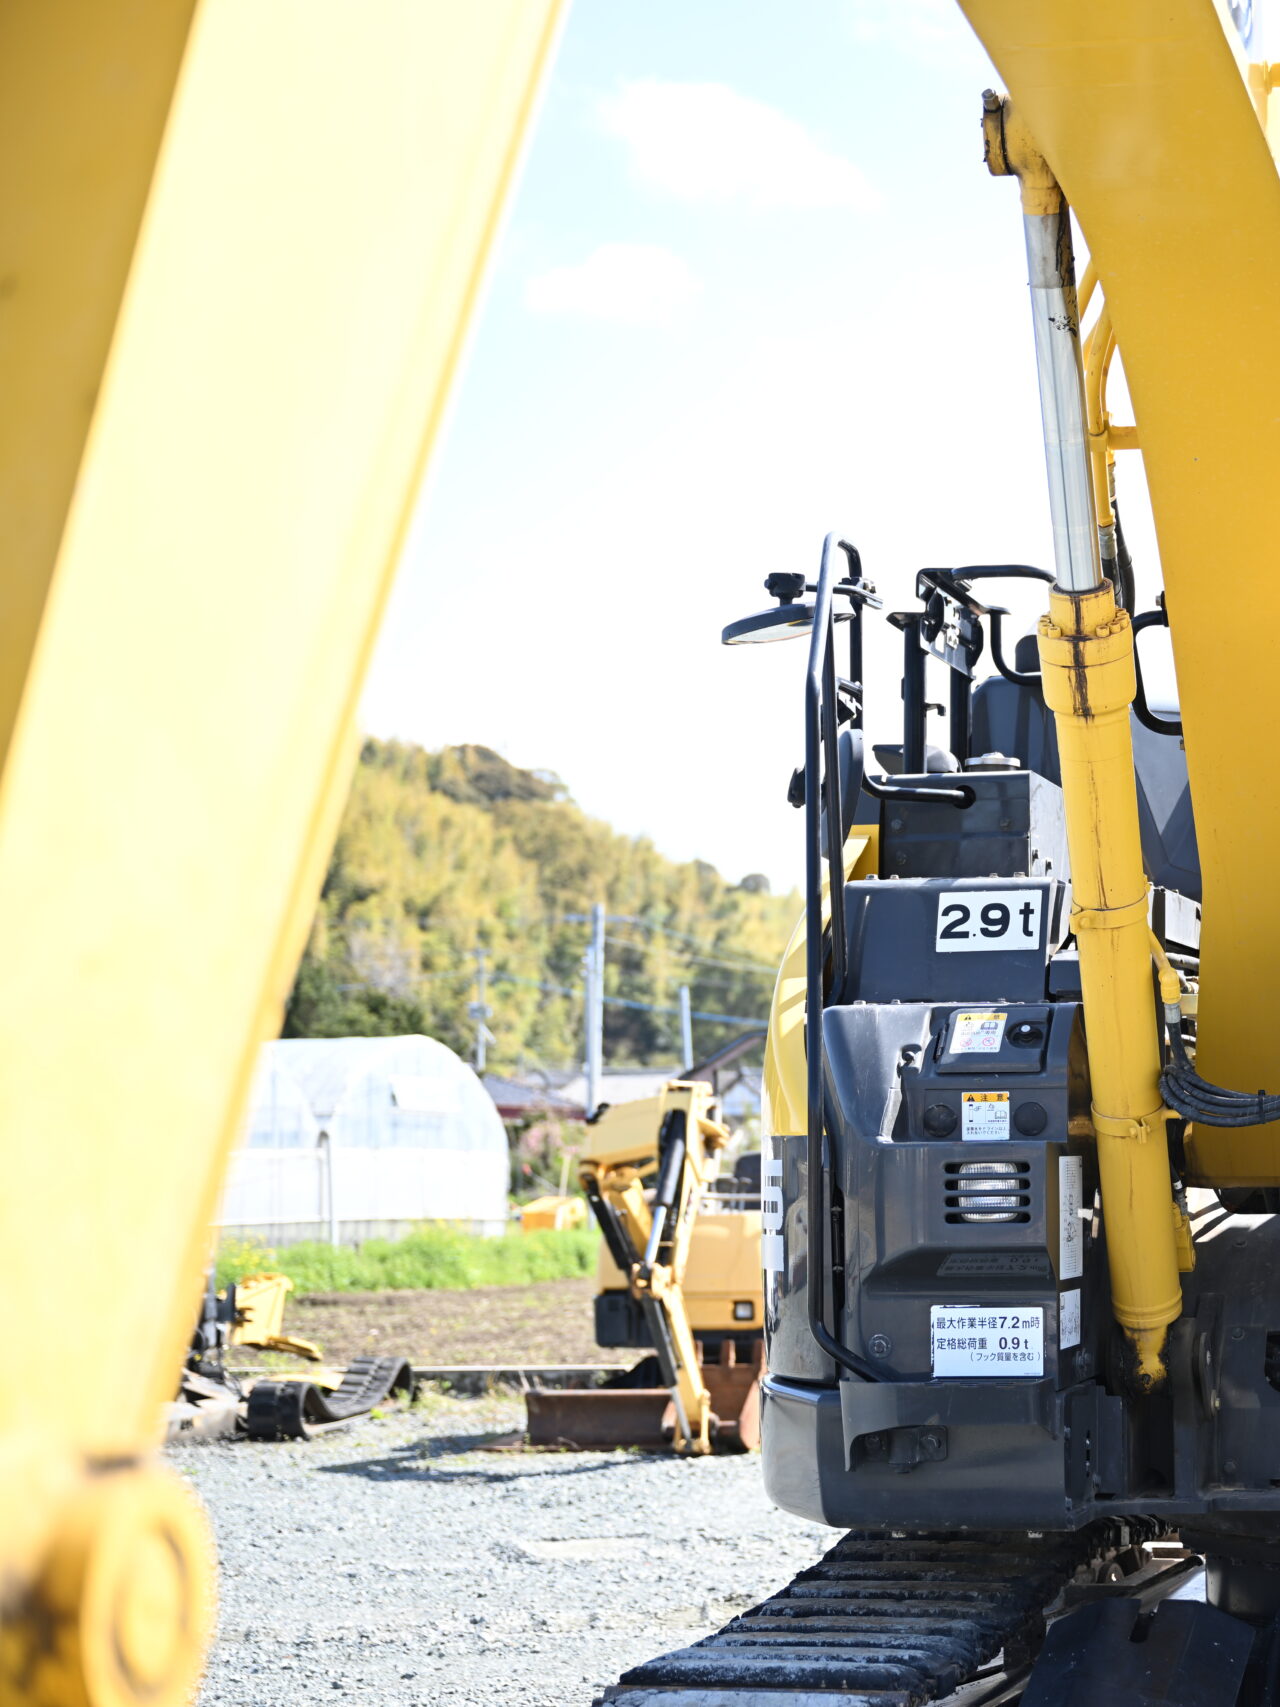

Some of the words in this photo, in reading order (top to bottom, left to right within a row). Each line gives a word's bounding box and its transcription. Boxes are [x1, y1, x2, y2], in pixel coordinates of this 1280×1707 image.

[936, 1337, 988, 1350] 定格総荷重
